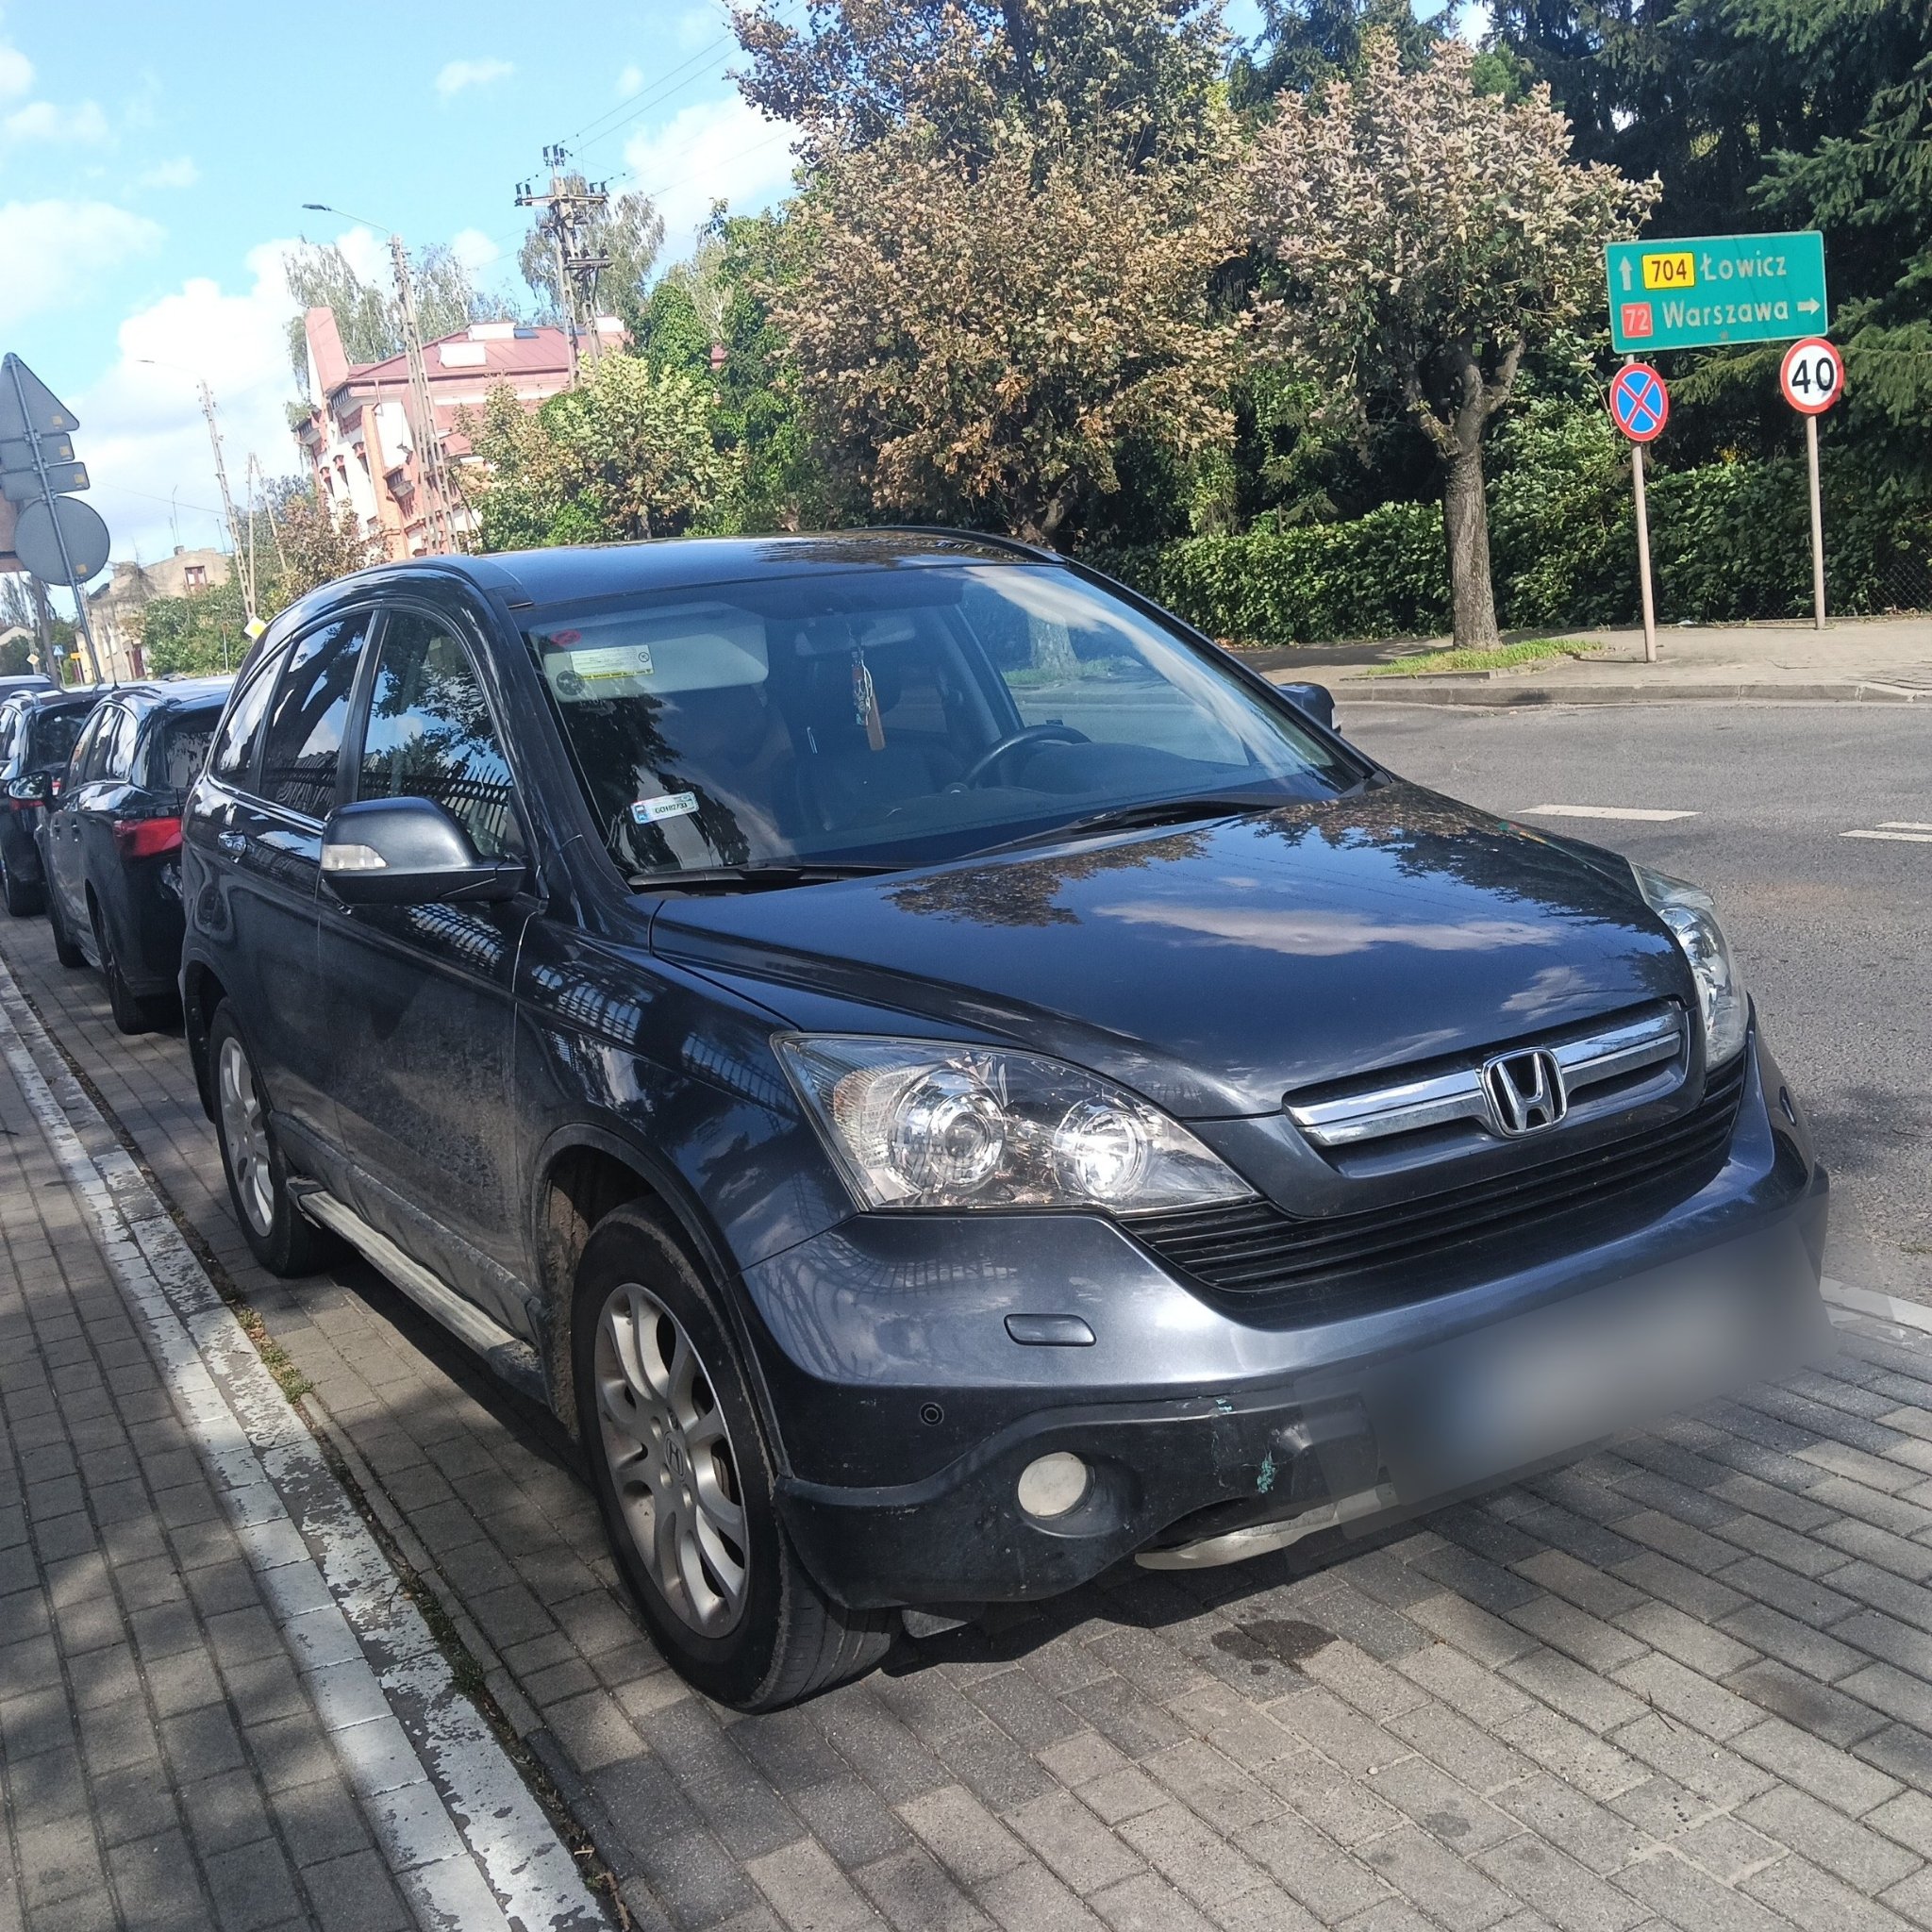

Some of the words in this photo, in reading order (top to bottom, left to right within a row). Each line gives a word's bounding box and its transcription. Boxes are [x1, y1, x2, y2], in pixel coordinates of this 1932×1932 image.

[1651, 258, 1688, 282] 704
[1700, 250, 1787, 281] Łowicz
[1624, 308, 1649, 331] 72
[1662, 299, 1789, 328] Warszawa
[1791, 357, 1835, 393] 40
